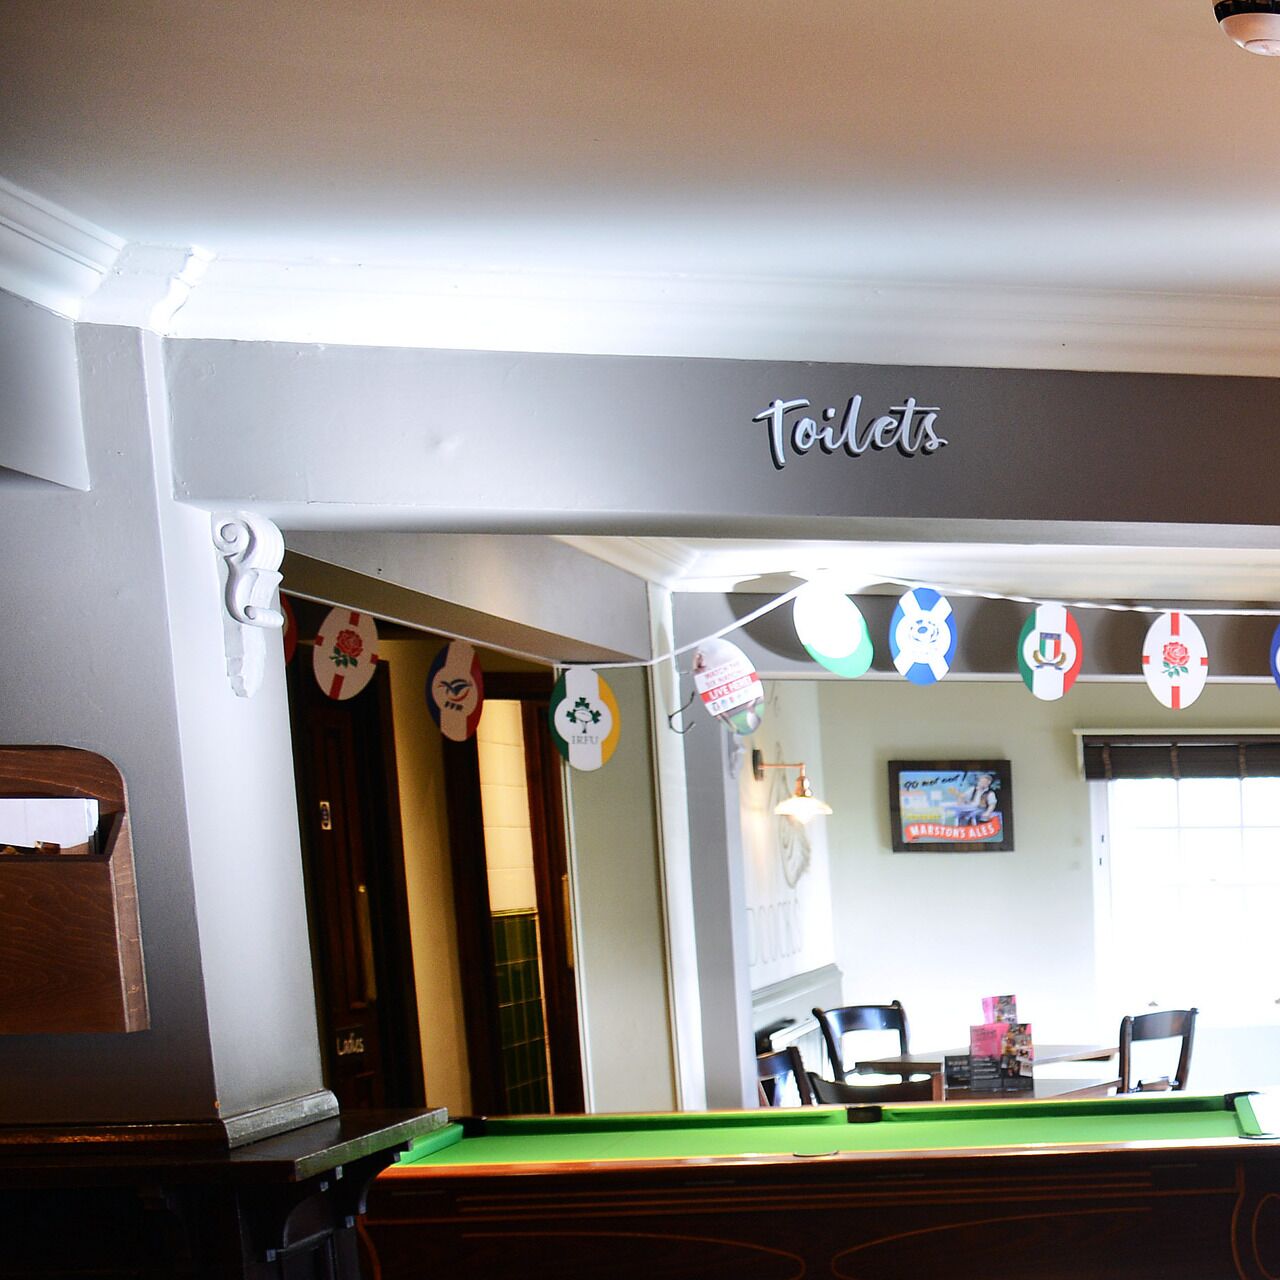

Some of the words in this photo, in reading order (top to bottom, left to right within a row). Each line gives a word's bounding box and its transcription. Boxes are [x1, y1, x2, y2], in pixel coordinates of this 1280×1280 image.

[752, 394, 949, 468] Toilets
[710, 685, 729, 699] LIVE
[571, 735, 599, 745] IRFU
[910, 823, 966, 839] MARSTON'S
[968, 824, 995, 838] ALES
